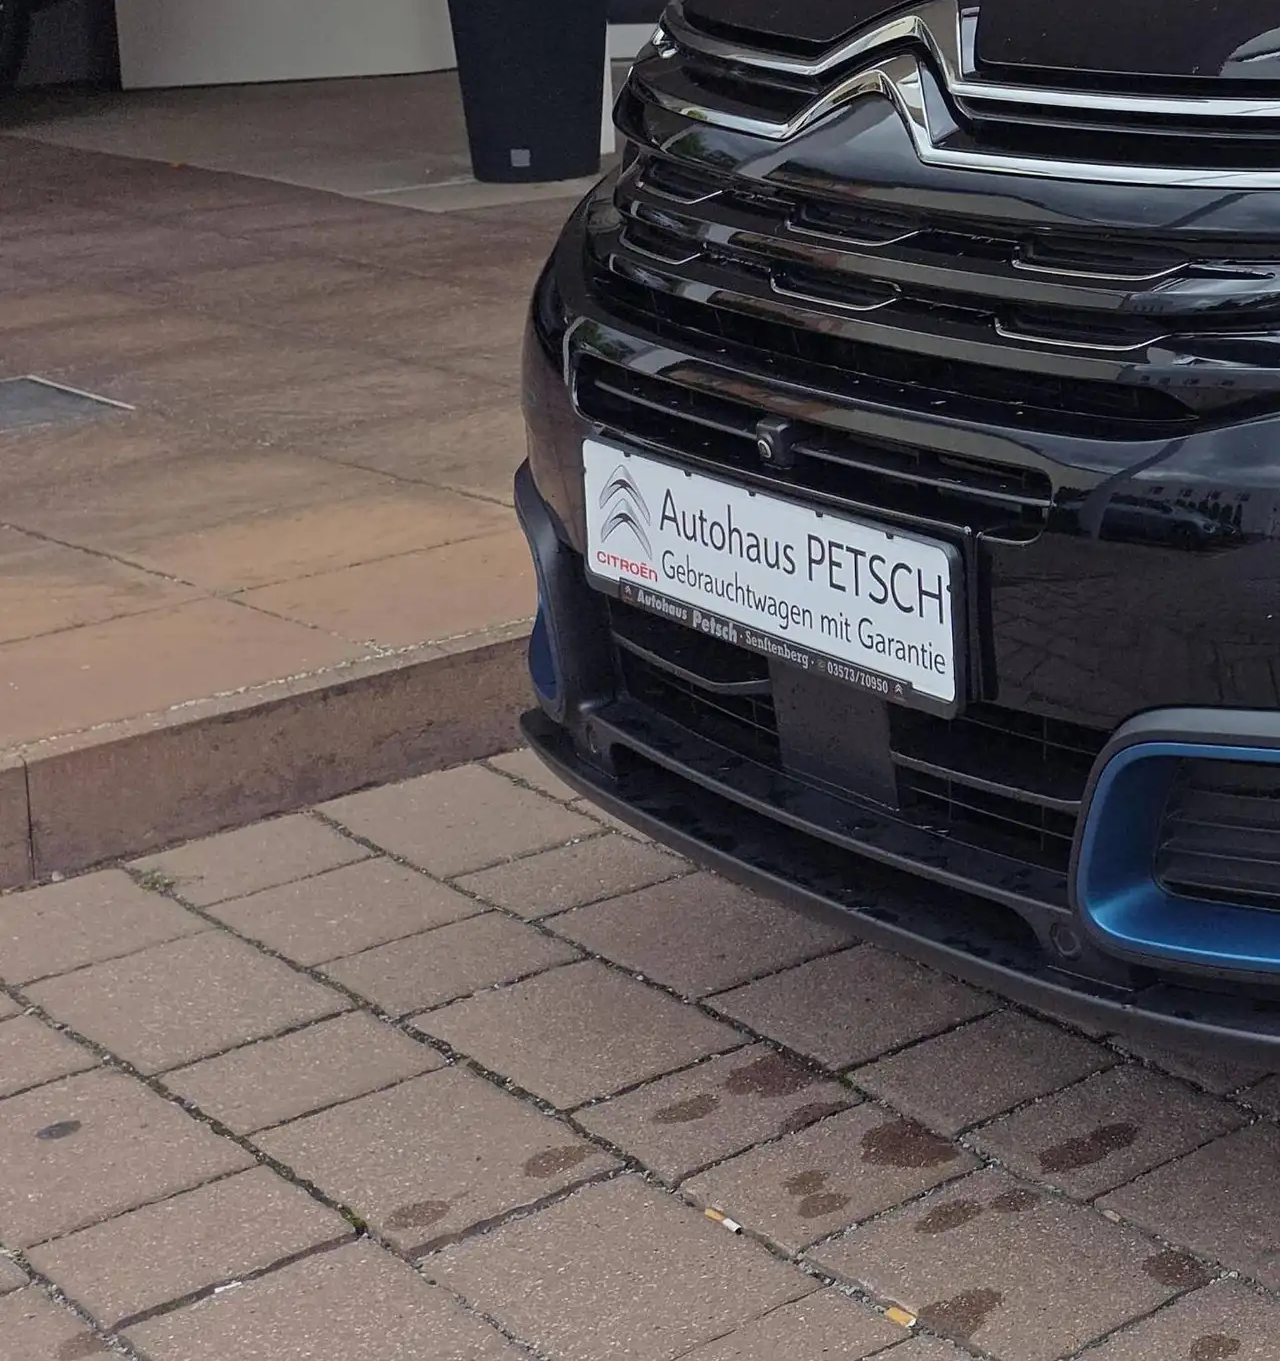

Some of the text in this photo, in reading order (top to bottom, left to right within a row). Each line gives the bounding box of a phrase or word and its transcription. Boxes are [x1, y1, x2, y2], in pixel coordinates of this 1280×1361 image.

[637, 589, 688, 621] Autohaus
[692, 610, 737, 644] Petsch
[659, 488, 944, 625] Autohaus PETSCH
[661, 549, 946, 674] Gebrauchtwagen mit Garantie
